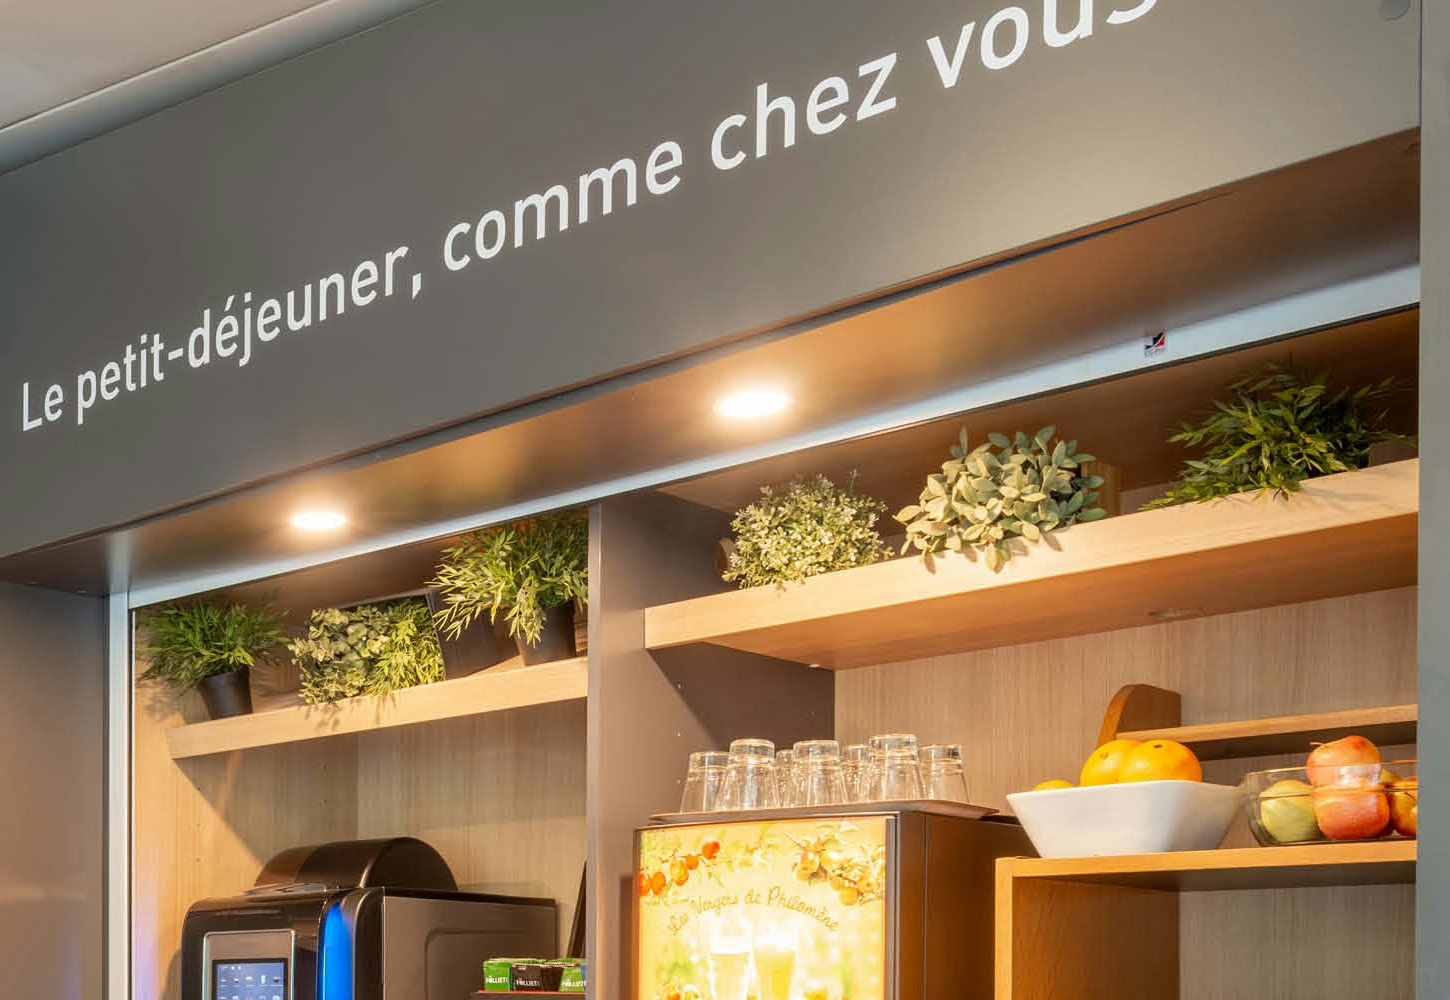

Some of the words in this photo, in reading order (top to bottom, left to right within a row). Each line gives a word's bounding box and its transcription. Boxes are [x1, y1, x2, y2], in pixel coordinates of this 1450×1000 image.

[21, 380, 65, 433] Le
[76, 245, 423, 427] petit-déjeuner,
[442, 139, 684, 273] comme
[709, 51, 898, 172] chez
